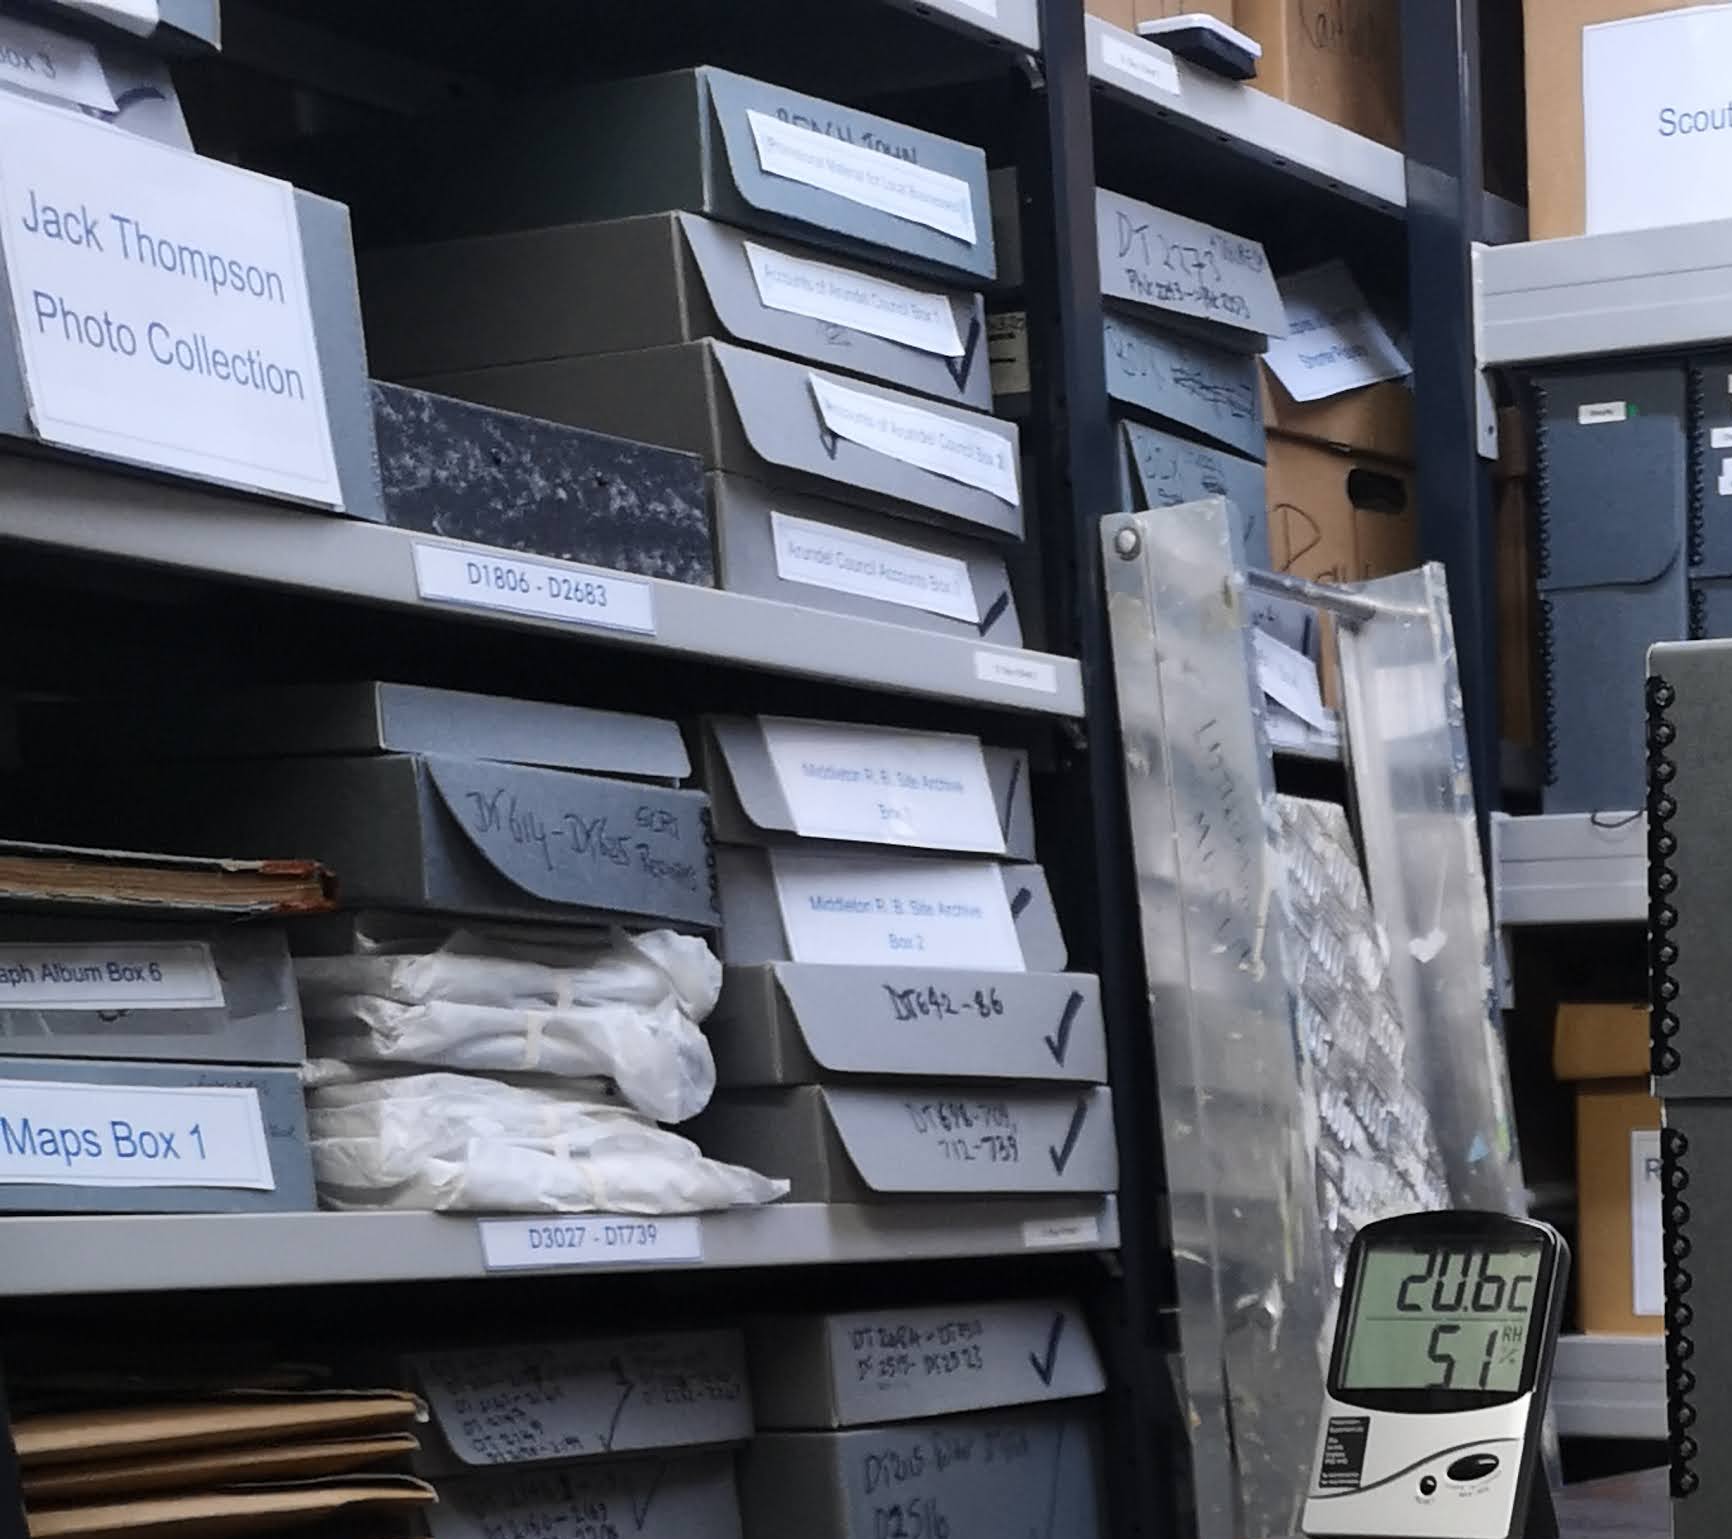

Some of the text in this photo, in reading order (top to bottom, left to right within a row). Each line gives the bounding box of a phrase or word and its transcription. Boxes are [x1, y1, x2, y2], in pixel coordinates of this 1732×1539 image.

[23, 190, 286, 304] Jack Thompson
[33, 290, 304, 401] Photo Collection
[467, 562, 531, 593] D1806
[548, 576, 607, 607] D2683
[41, 961, 101, 983] Album
[106, 960, 145, 982] Box
[148, 961, 163, 983] 6
[0, 1116, 206, 1168] Maps Box 1
[528, 1226, 586, 1249] D3027
[604, 1223, 658, 1246] DT739
